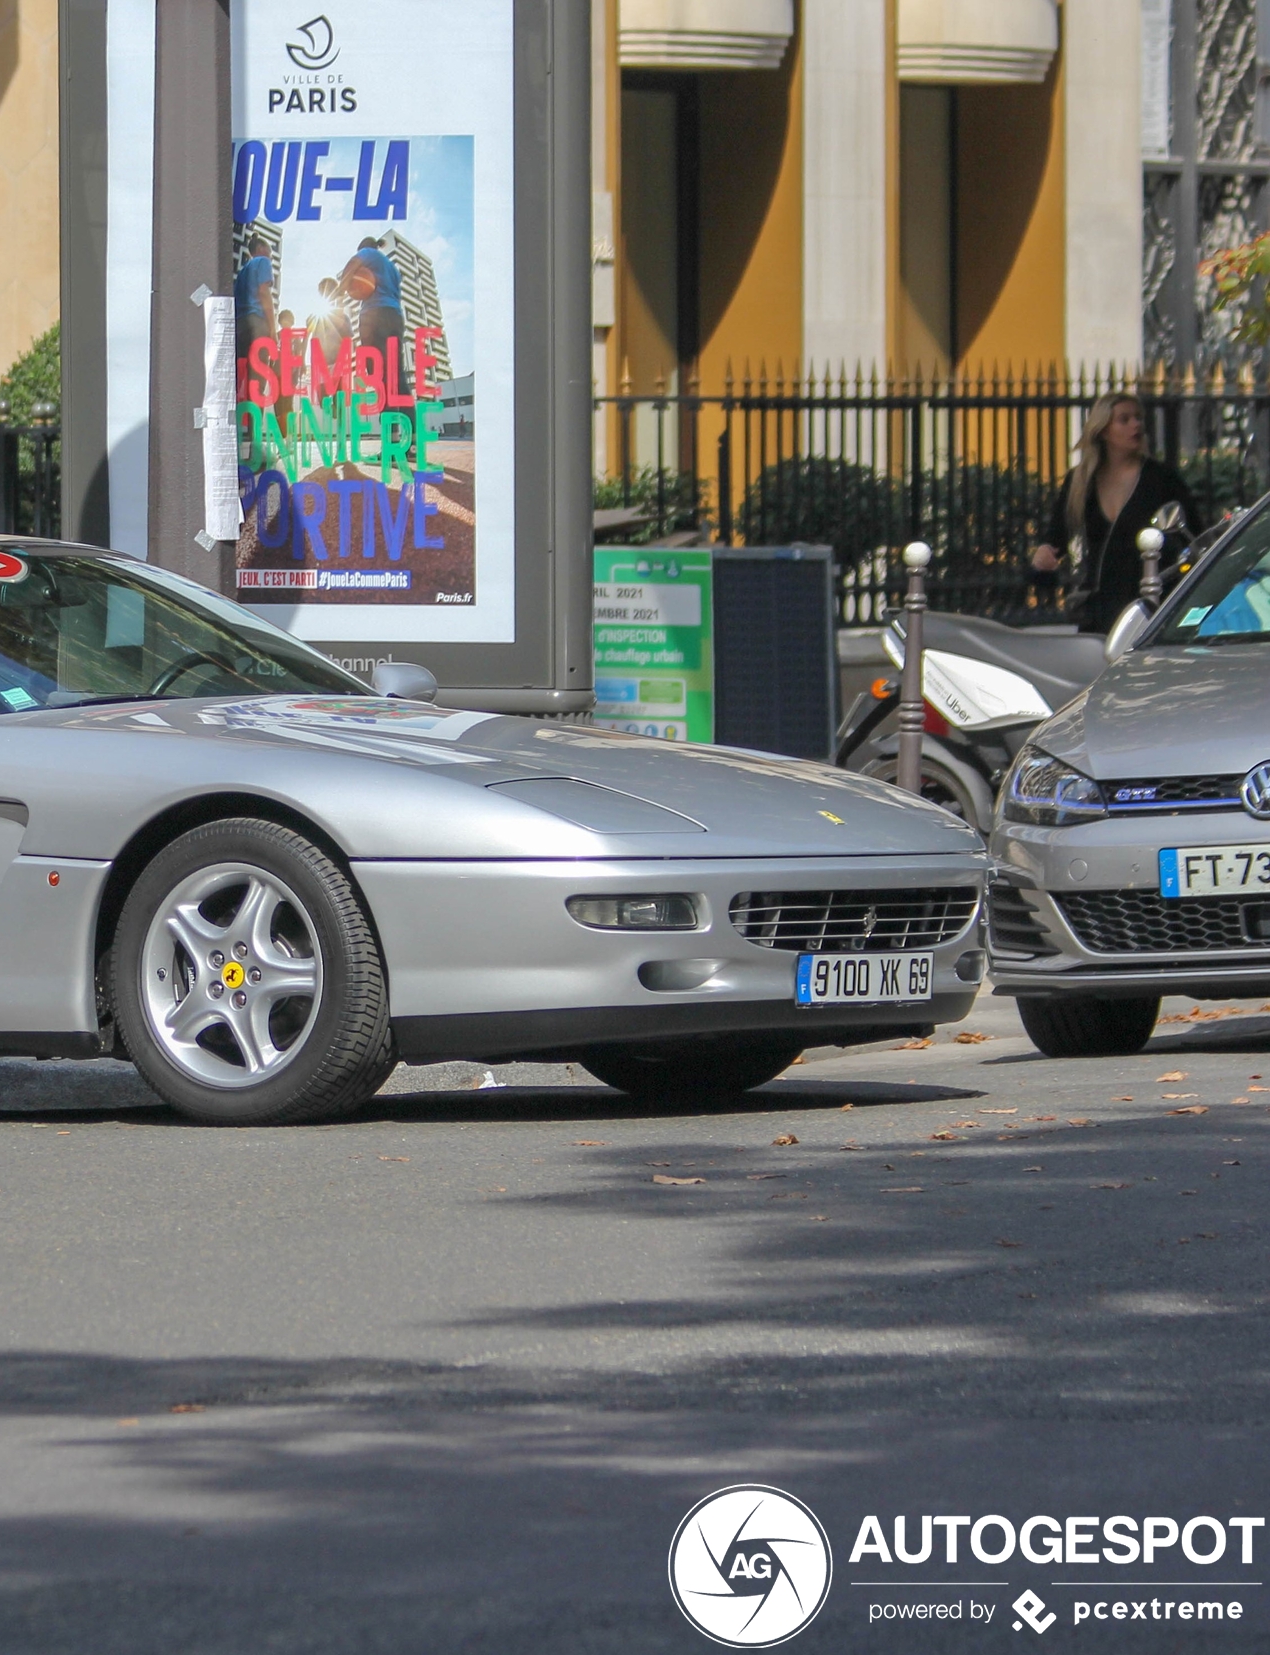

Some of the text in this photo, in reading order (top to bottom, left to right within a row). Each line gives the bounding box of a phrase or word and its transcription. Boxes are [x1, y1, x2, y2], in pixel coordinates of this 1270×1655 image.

[283, 74, 344, 84] VILLE DE
[268, 86, 358, 113] PARIS
[231, 140, 410, 224] OUE-LA
[264, 571, 286, 586] C'EST
[290, 571, 315, 586] PARTI
[319, 571, 408, 589] #JoueLaCommeParis
[436, 592, 473, 603] Paris.fr
[617, 588, 643, 598] 2021
[633, 609, 659, 620] 2021
[605, 648, 651, 667] chauffage
[946, 693, 971, 722] Uber
[815, 958, 929, 997] 9100 XK 69
